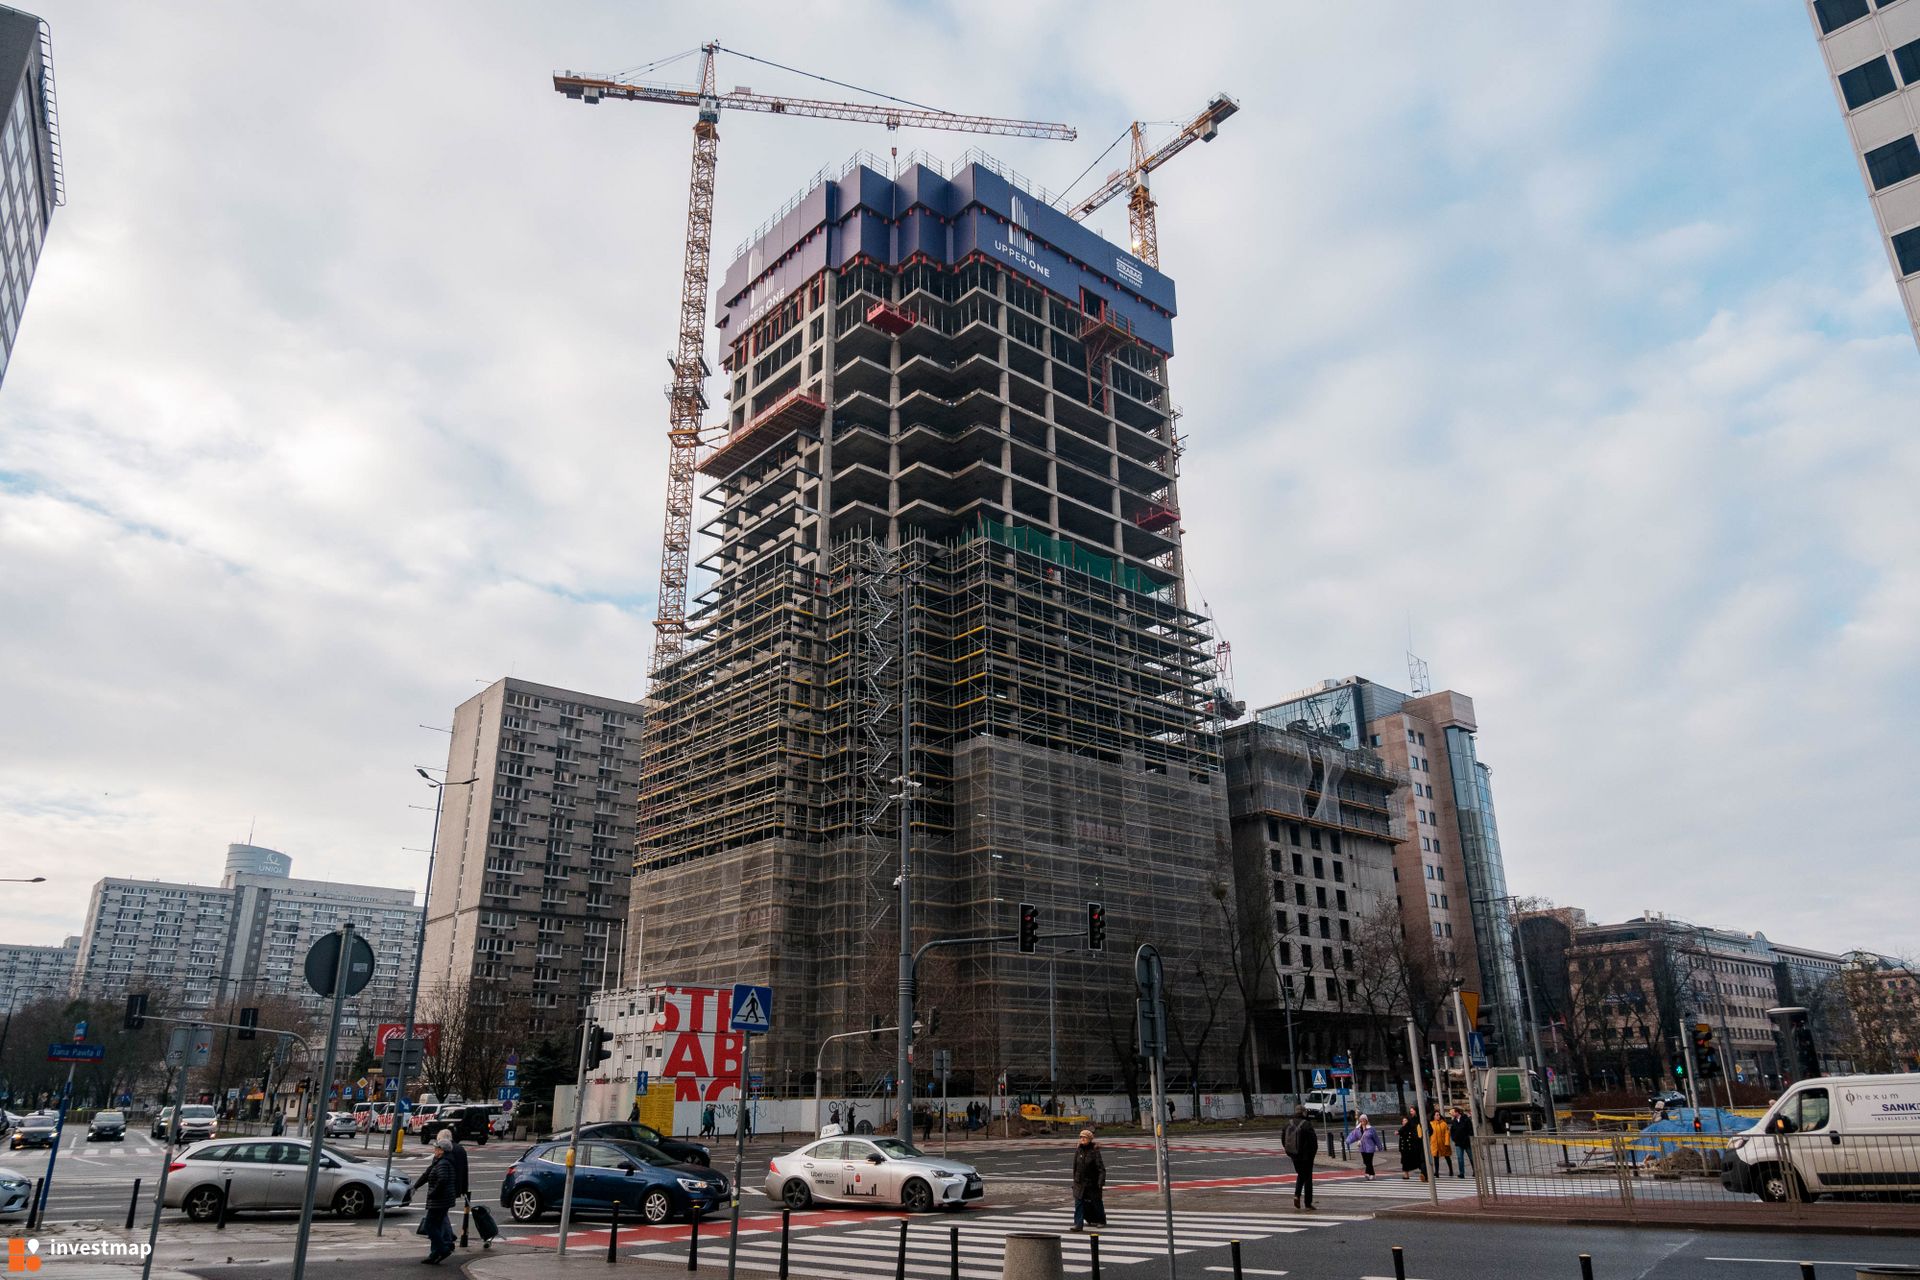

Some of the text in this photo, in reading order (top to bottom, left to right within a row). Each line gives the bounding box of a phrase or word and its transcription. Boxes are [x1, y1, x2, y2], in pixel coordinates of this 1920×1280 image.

[994, 240, 1051, 278] UPPER ONE
[1116, 261, 1143, 281] STRABAG
[737, 287, 785, 335] UPPER ONE
[662, 1033, 744, 1077] AB
